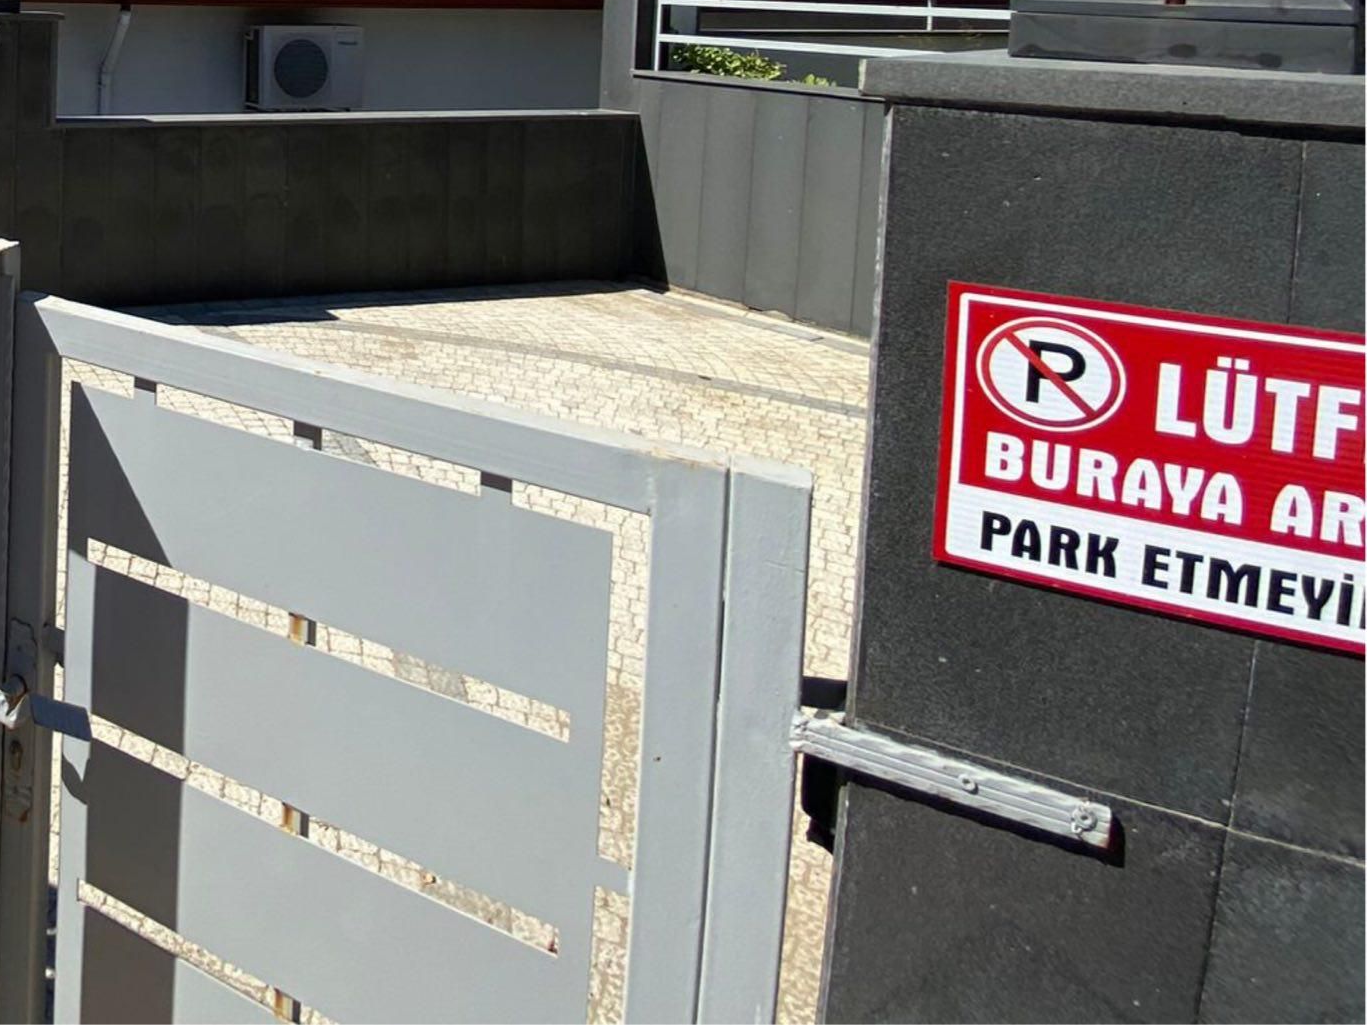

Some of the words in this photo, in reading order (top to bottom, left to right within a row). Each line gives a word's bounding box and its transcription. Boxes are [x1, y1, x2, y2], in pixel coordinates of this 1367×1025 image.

[1154, 357, 1365, 461] LÜTF
[984, 431, 1243, 526] BURAYA
[980, 511, 1120, 578] PARK
[1142, 544, 1365, 630] ETMEYİ
